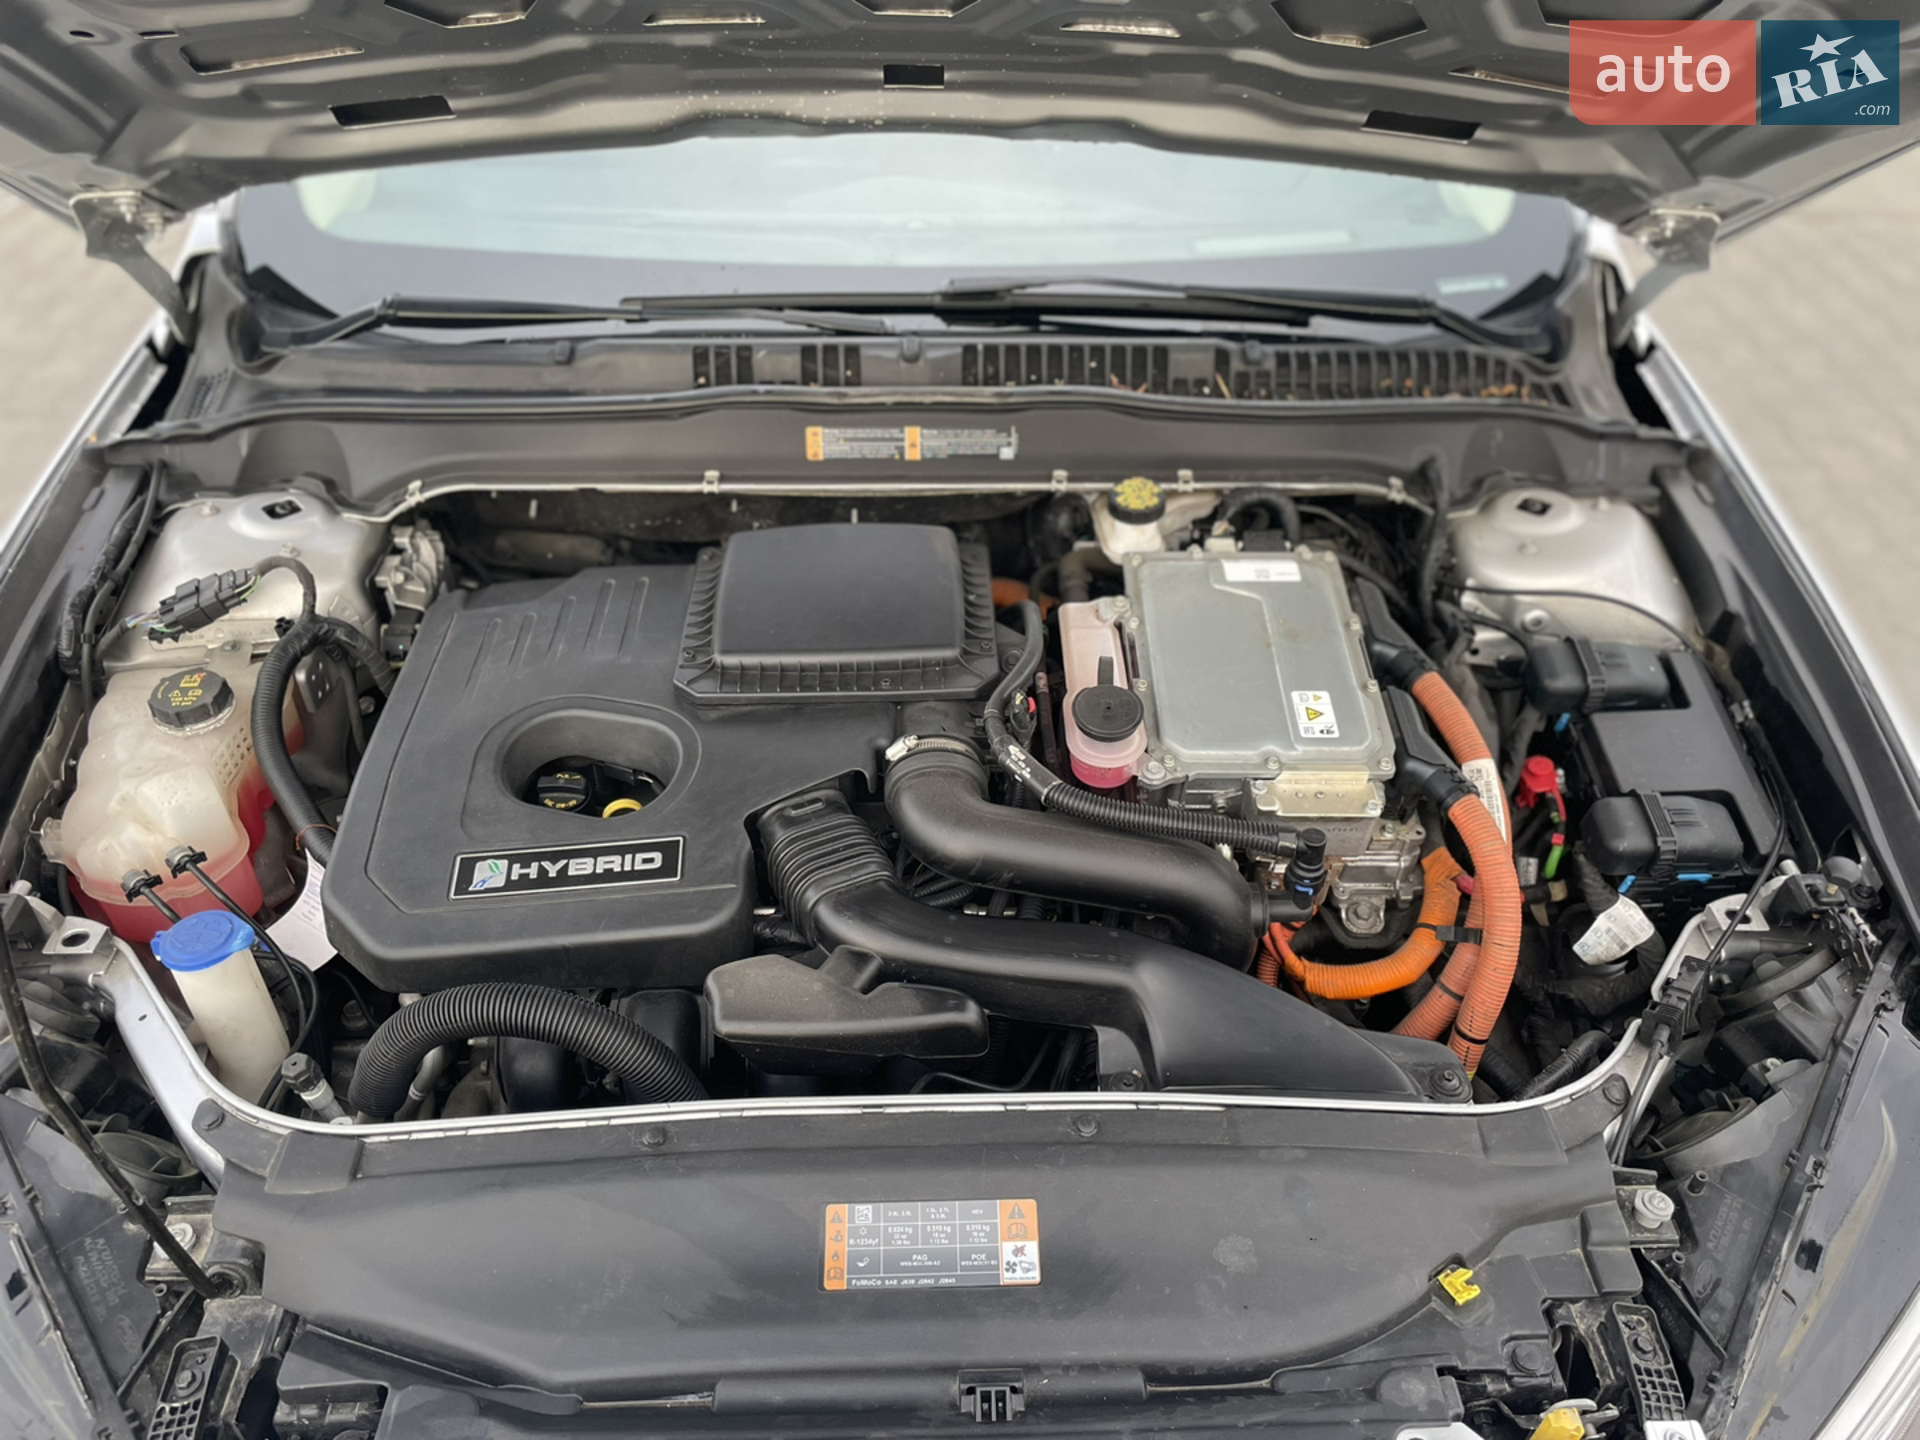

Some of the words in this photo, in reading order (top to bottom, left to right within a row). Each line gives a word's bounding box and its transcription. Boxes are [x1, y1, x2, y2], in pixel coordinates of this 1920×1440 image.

[510, 852, 662, 880] HYBRID
[904, 1226, 913, 1234] kg
[943, 1225, 951, 1233] kg
[982, 1224, 990, 1232] kg
[971, 1253, 987, 1261] POE
[852, 1278, 882, 1286] FoMoCo
